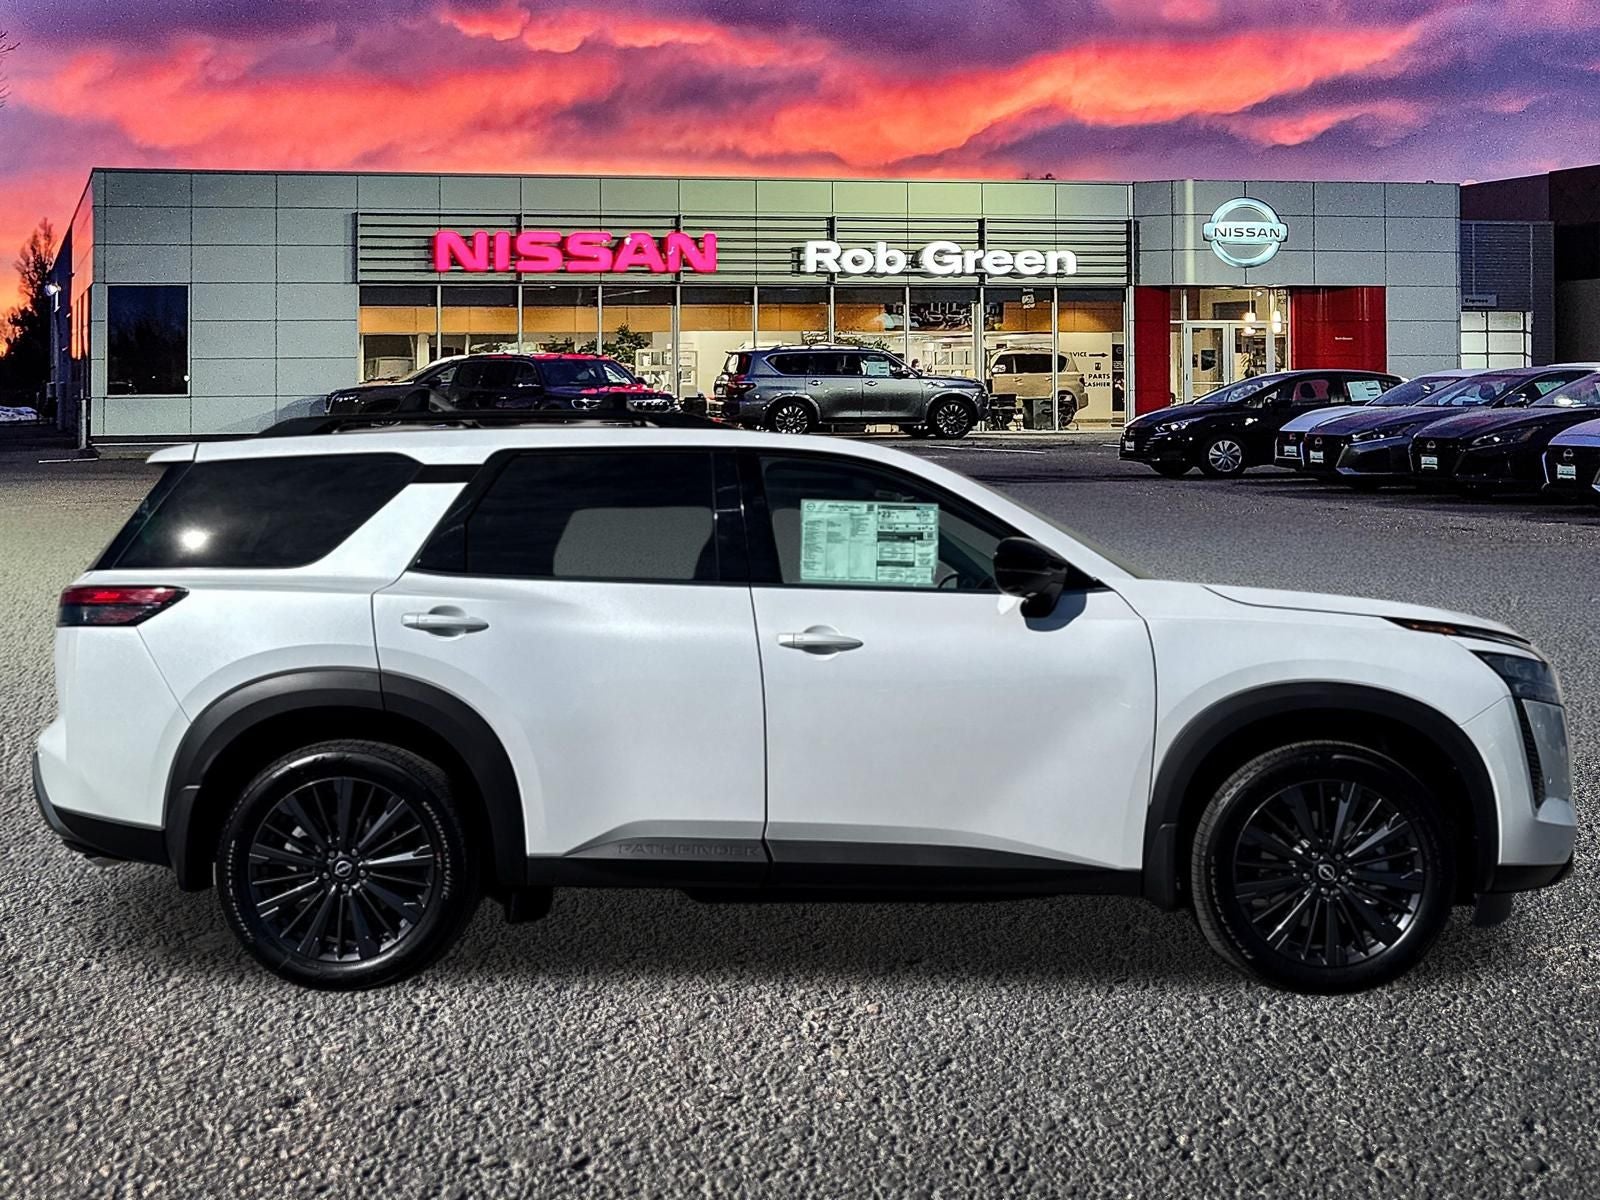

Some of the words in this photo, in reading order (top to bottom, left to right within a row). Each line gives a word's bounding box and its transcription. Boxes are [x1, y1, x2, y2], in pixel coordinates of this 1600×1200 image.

[1214, 227, 1280, 238] NISSAN
[434, 230, 718, 273] NISSAN
[804, 240, 908, 275] Rob
[921, 240, 1078, 276] Green
[617, 843, 760, 857] PATHFINDER
